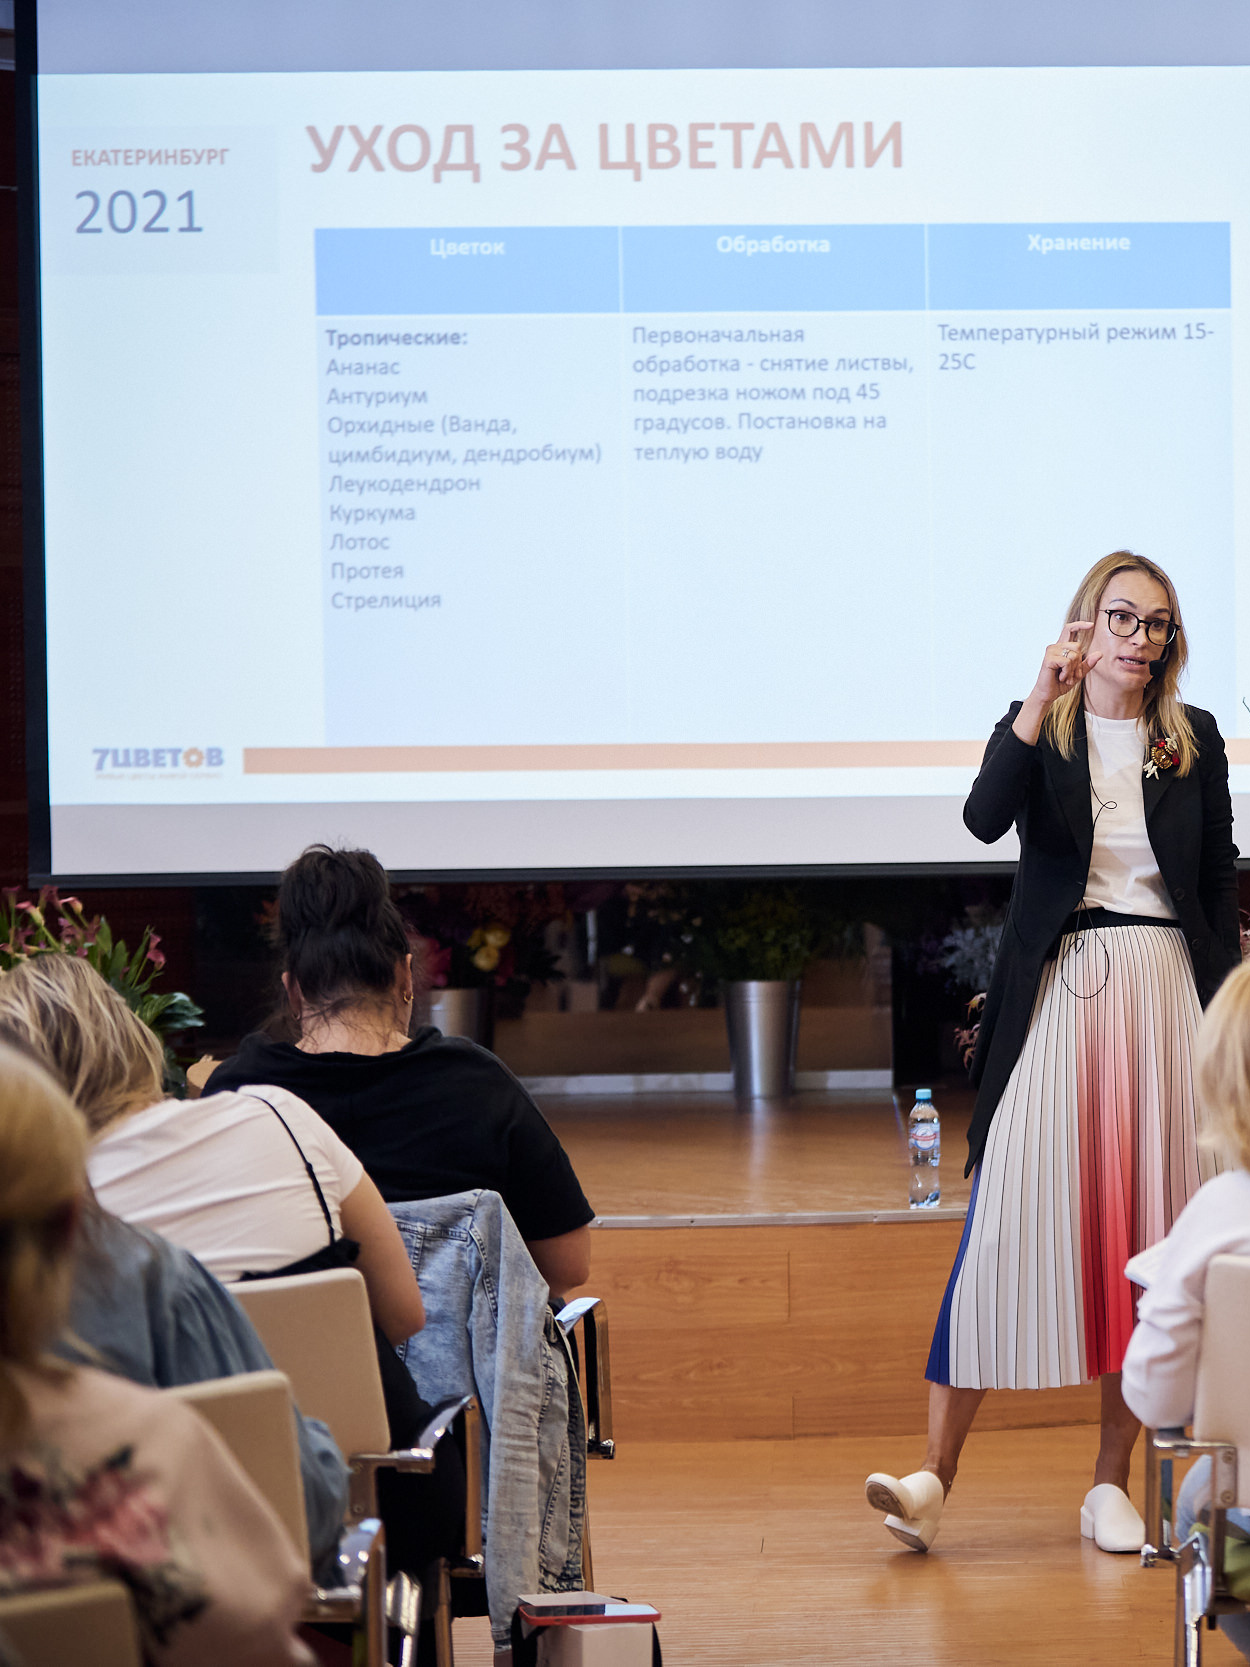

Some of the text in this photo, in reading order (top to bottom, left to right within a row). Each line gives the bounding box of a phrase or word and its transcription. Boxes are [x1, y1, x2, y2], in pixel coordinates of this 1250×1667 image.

[71, 148, 230, 167] ЕКАТЕРИНБУРГ
[305, 121, 904, 184] УХОД ЗА ЦВЕТАМИ
[75, 189, 204, 234] 2021
[429, 239, 505, 258] Цветок
[716, 235, 831, 256] Обработка
[1027, 233, 1132, 255] Хранение
[325, 328, 468, 350] Тропические:
[632, 326, 805, 347] Первоначальная
[937, 322, 1215, 345] Температурный режим 15-
[326, 358, 401, 376] Ананас
[632, 355, 741, 375] обработка
[759, 357, 829, 372] снятие
[835, 356, 914, 374] листвы,
[326, 387, 428, 408] Антуриум
[633, 383, 881, 405] подрезка ножом под 45
[327, 414, 518, 436] Орхидные (Ванда,
[634, 413, 887, 435] градусов. Постановка на
[328, 443, 603, 466] цимбидиум, дендробиум)
[634, 445, 764, 464] теплую воду
[328, 474, 481, 496] Леукодендрон
[329, 504, 416, 525] Куркума
[329, 533, 391, 551] Лотос
[330, 562, 405, 582] Протея
[330, 591, 442, 612] Стрелиция
[92, 747, 225, 772] 7ЦВЕТОВ
